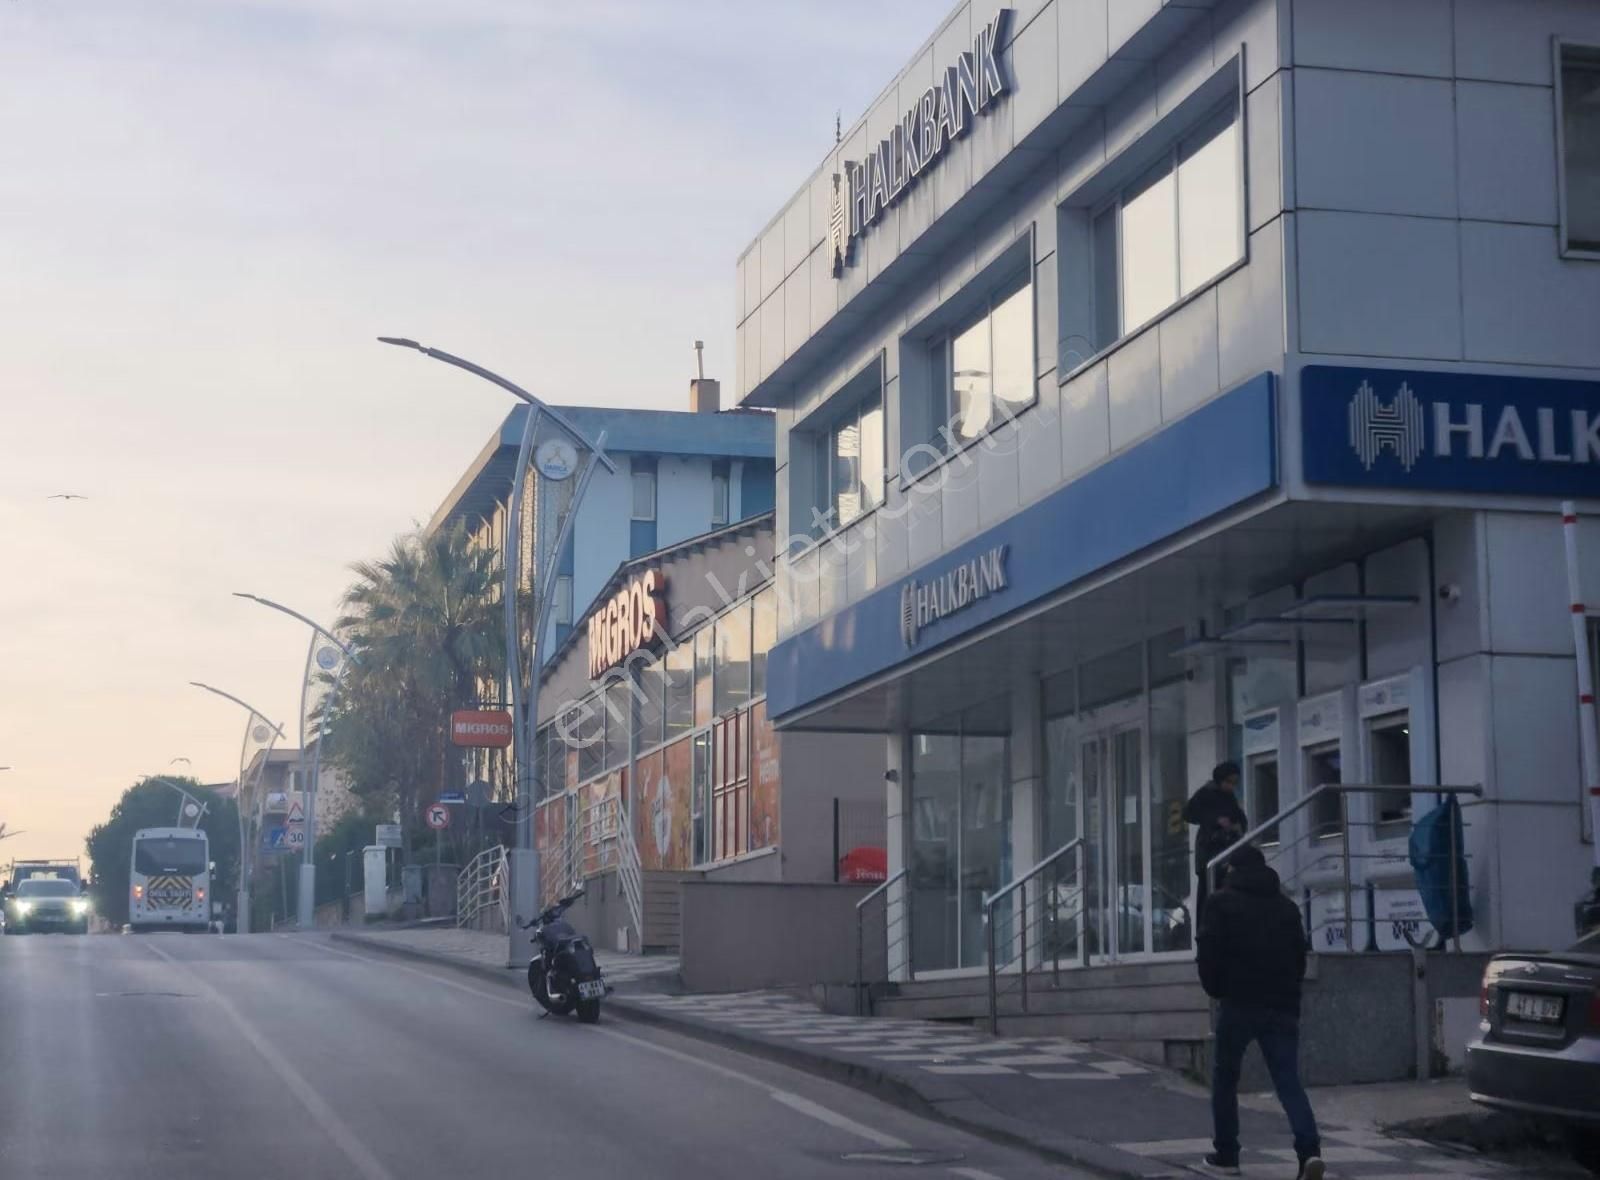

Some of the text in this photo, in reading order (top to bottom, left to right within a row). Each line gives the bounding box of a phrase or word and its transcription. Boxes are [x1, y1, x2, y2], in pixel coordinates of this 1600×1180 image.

[851, 9, 1014, 237] HALKBANK
[1432, 402, 1600, 463] HALK
[917, 544, 1010, 628] HALKBANK
[455, 722, 509, 735] MIGROS
[290, 832, 304, 843] 30
